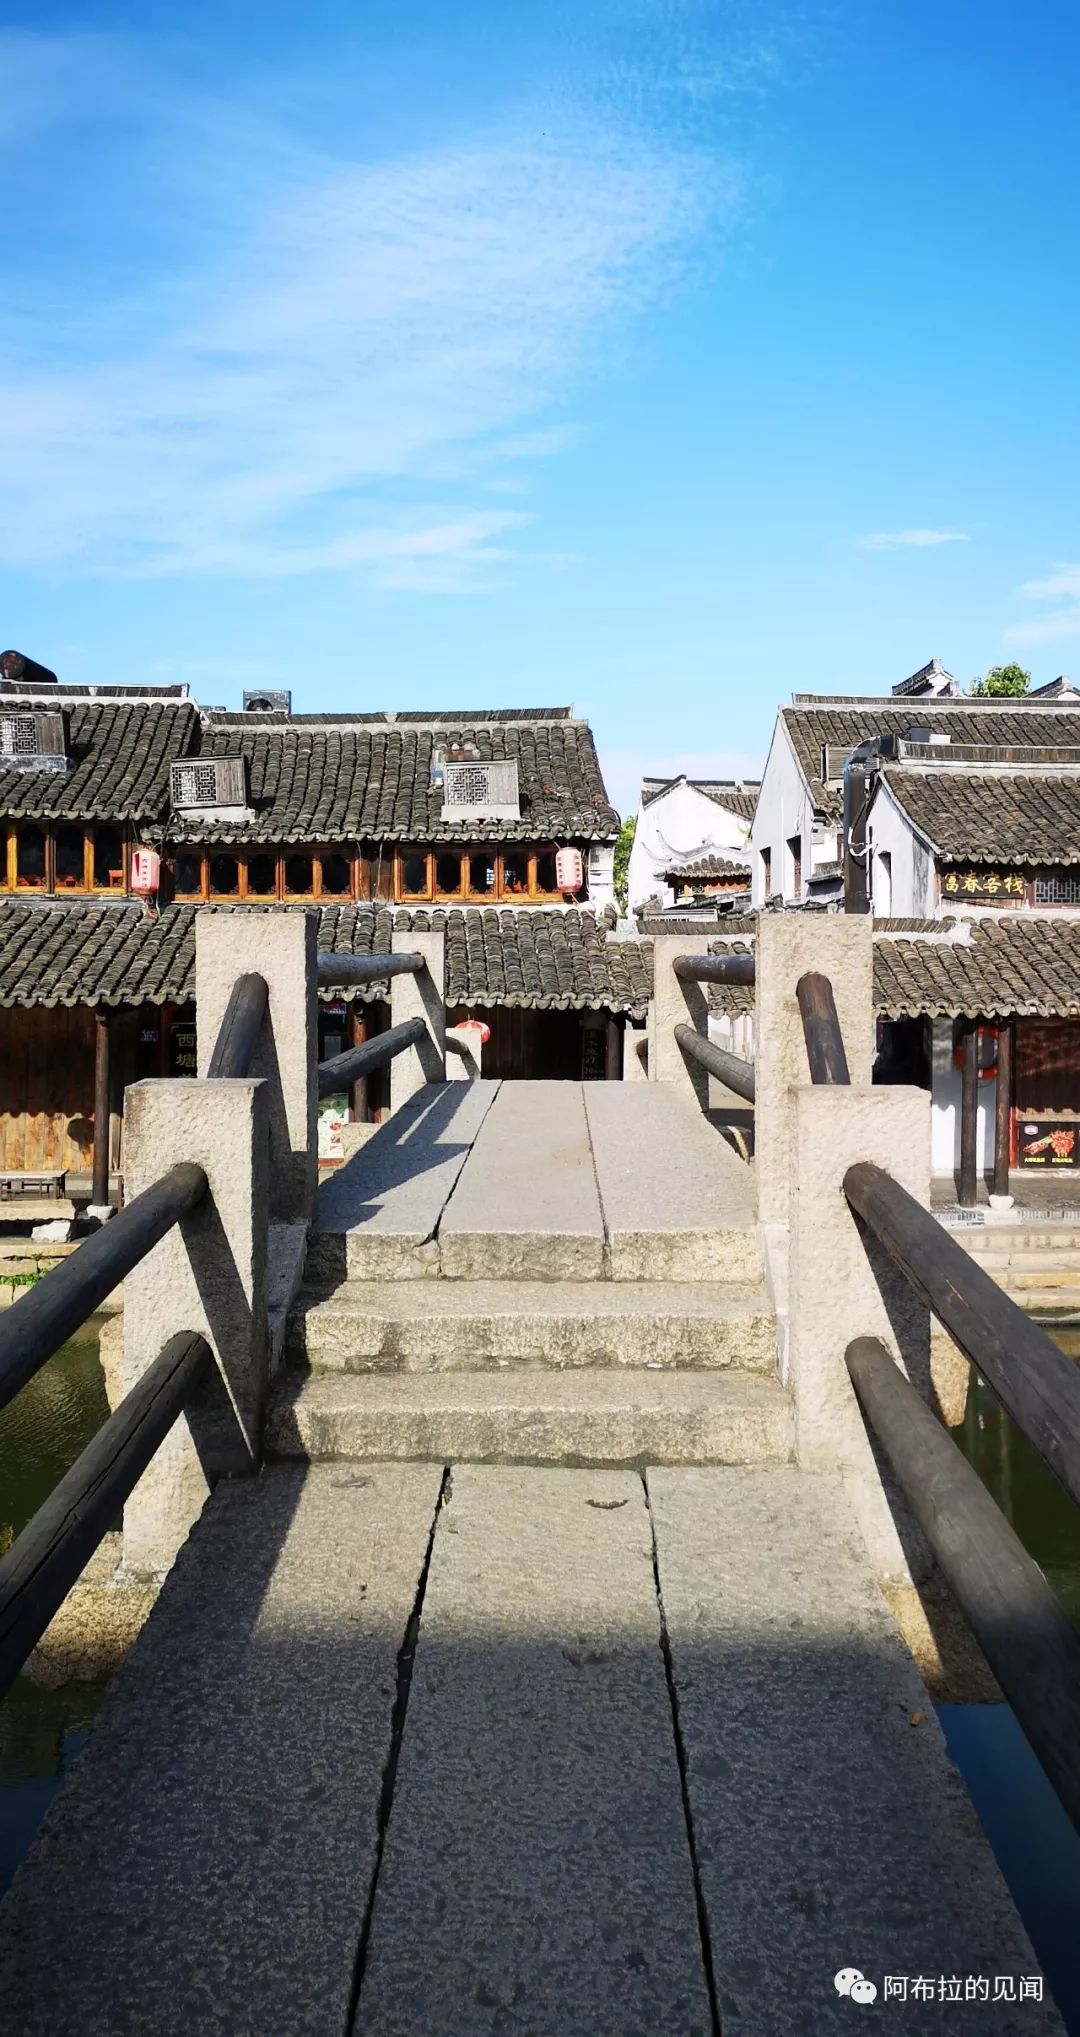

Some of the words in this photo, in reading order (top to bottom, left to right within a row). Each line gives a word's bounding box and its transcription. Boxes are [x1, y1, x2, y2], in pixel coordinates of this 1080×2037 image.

[945, 869, 1024, 895] 富春客栈
[175, 1033, 197, 1078] 西塘
